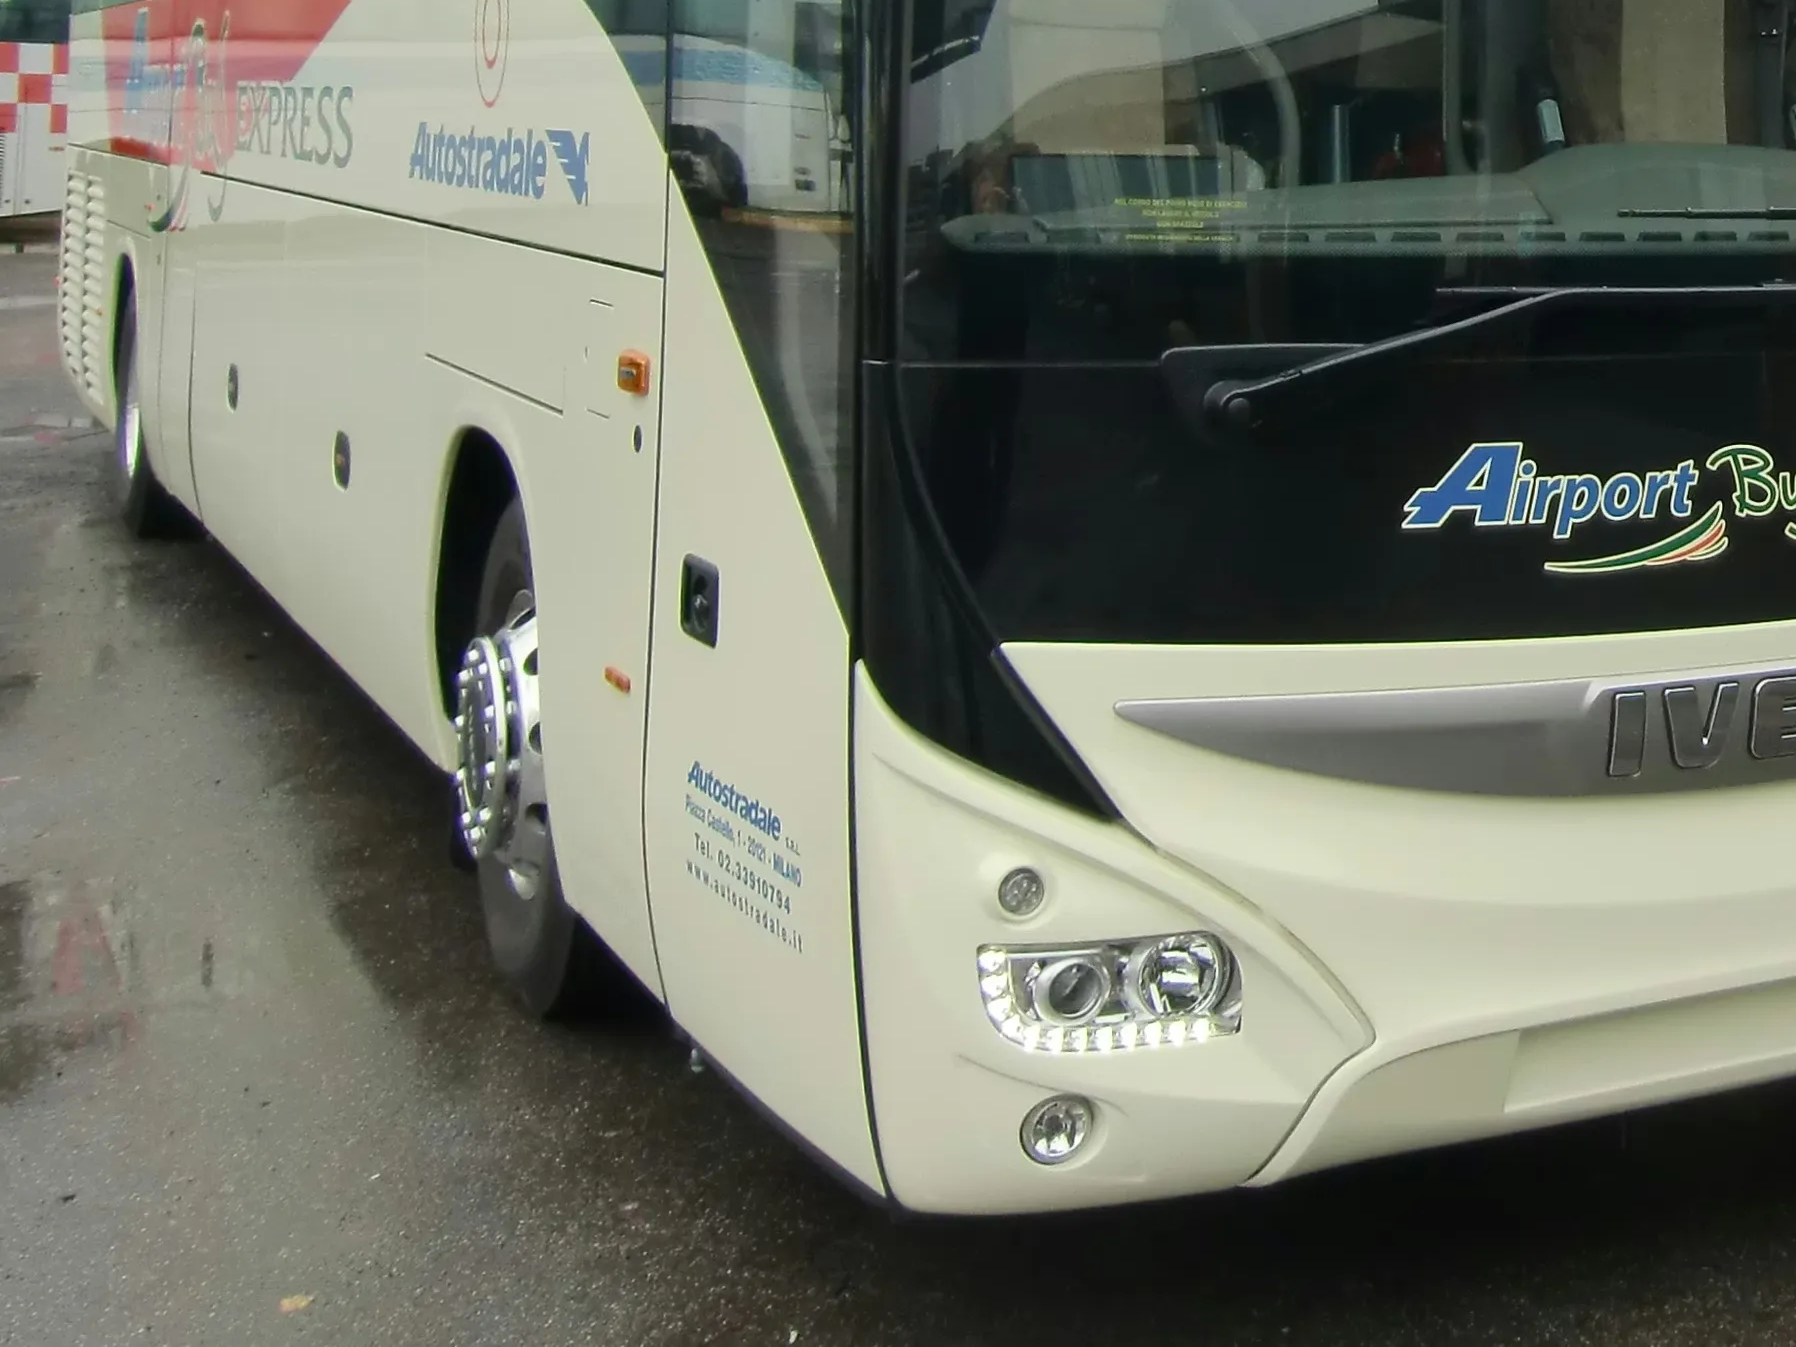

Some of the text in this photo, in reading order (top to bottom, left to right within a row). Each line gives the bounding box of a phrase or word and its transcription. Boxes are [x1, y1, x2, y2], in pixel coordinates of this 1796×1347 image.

[237, 81, 353, 169] EXPRESS
[409, 122, 547, 200] Autostradale
[1401, 440, 1699, 540] Airport
[687, 760, 781, 841] Autostradale
[686, 859, 803, 954] www.autostradale.it
[694, 832, 792, 915] Tel. 02.33910794
[772, 852, 803, 888] MILANO
